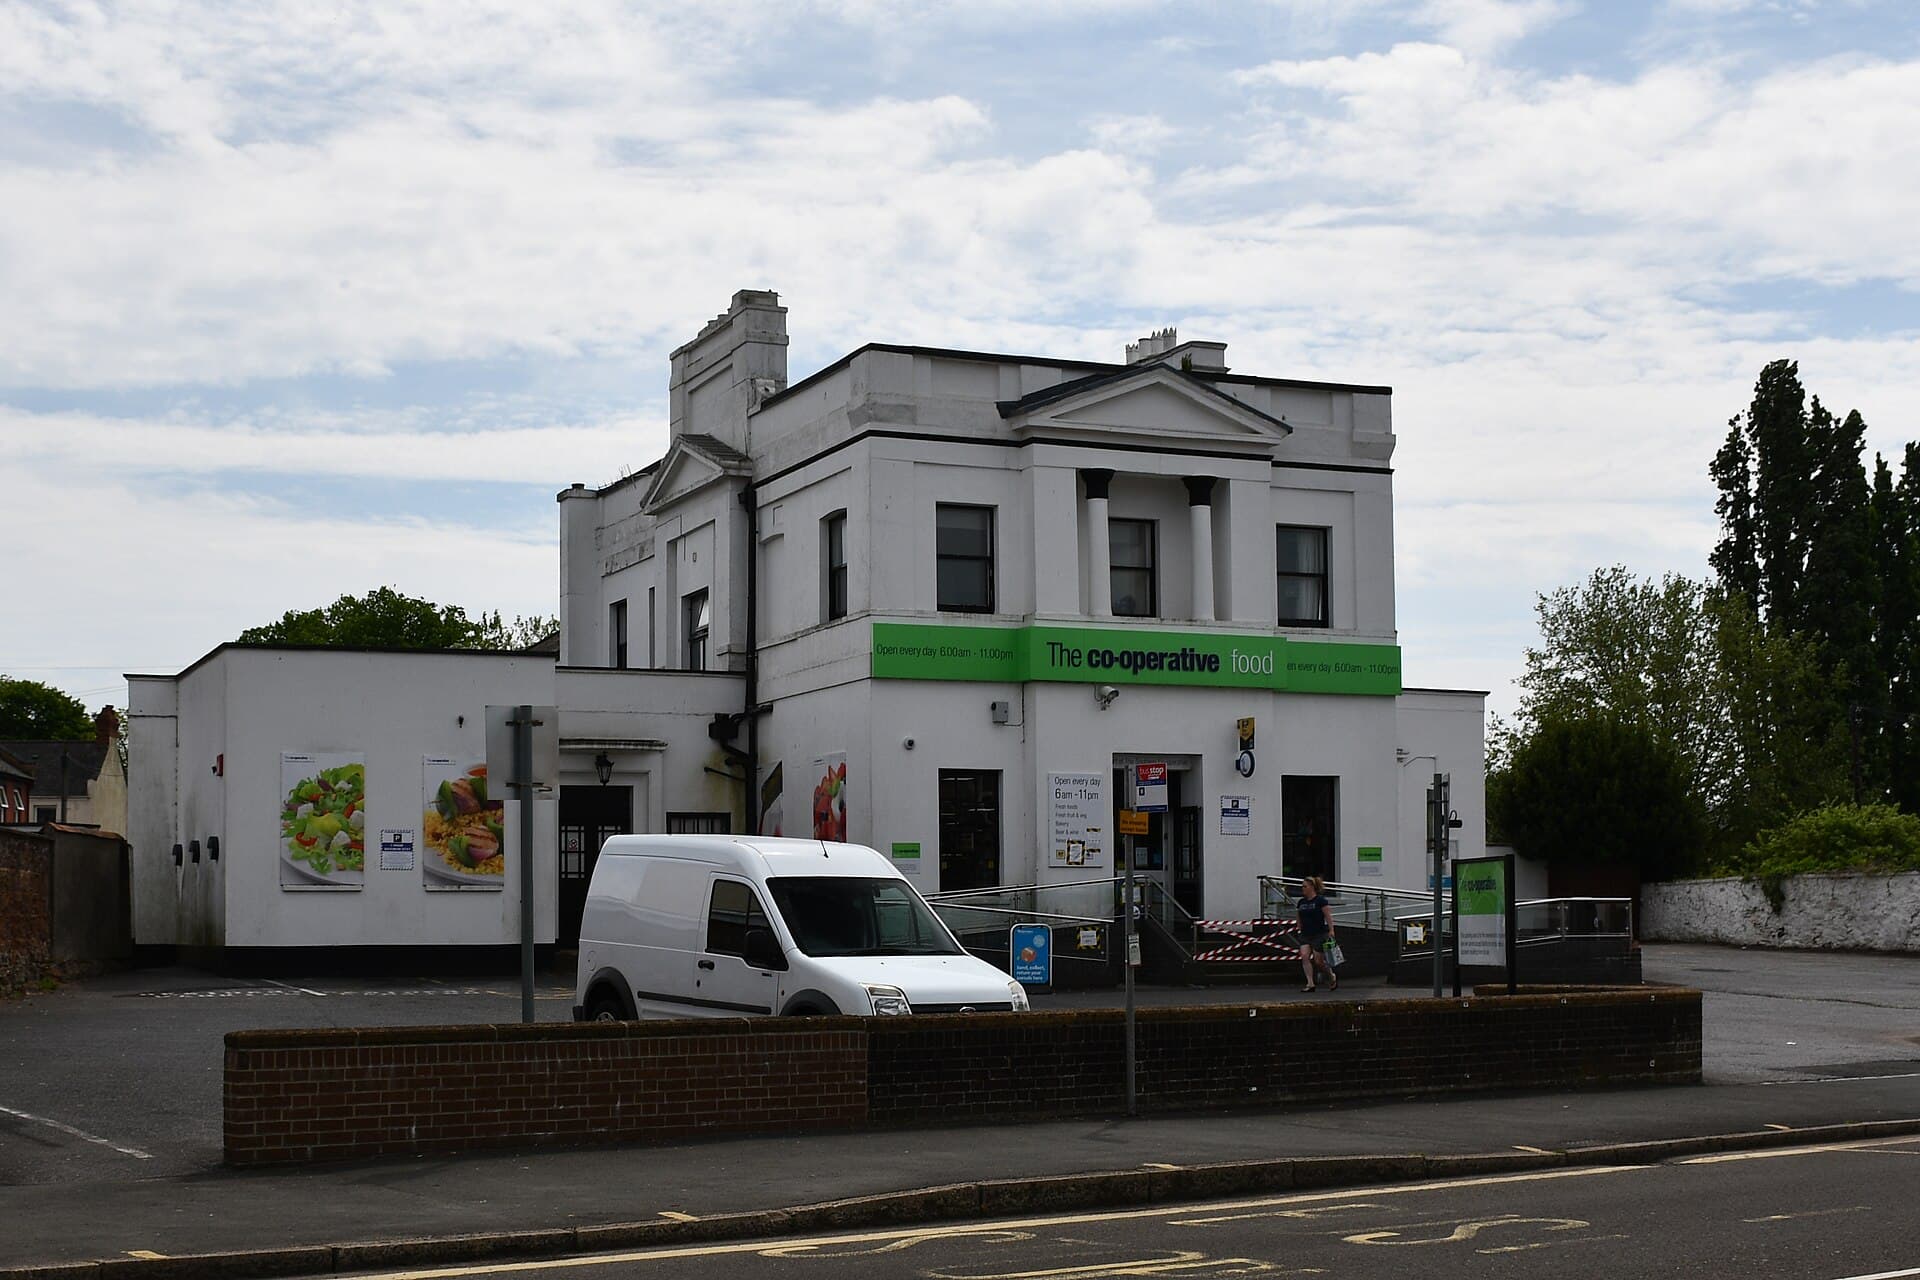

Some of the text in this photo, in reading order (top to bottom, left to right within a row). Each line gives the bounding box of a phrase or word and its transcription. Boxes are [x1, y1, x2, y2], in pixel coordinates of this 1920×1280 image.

[876, 643, 898, 658] Open
[899, 646, 920, 658] every
[922, 645, 937, 659] day
[939, 646, 971, 658] 6.00am
[979, 648, 1014, 661] 11.00pm
[1046, 641, 1273, 676] The co-operative food
[1298, 663, 1317, 673] every
[1318, 662, 1331, 674] day
[1149, 766, 1164, 776] stop
[1054, 776, 1101, 788] Open every day
[1055, 788, 1073, 800] 6am
